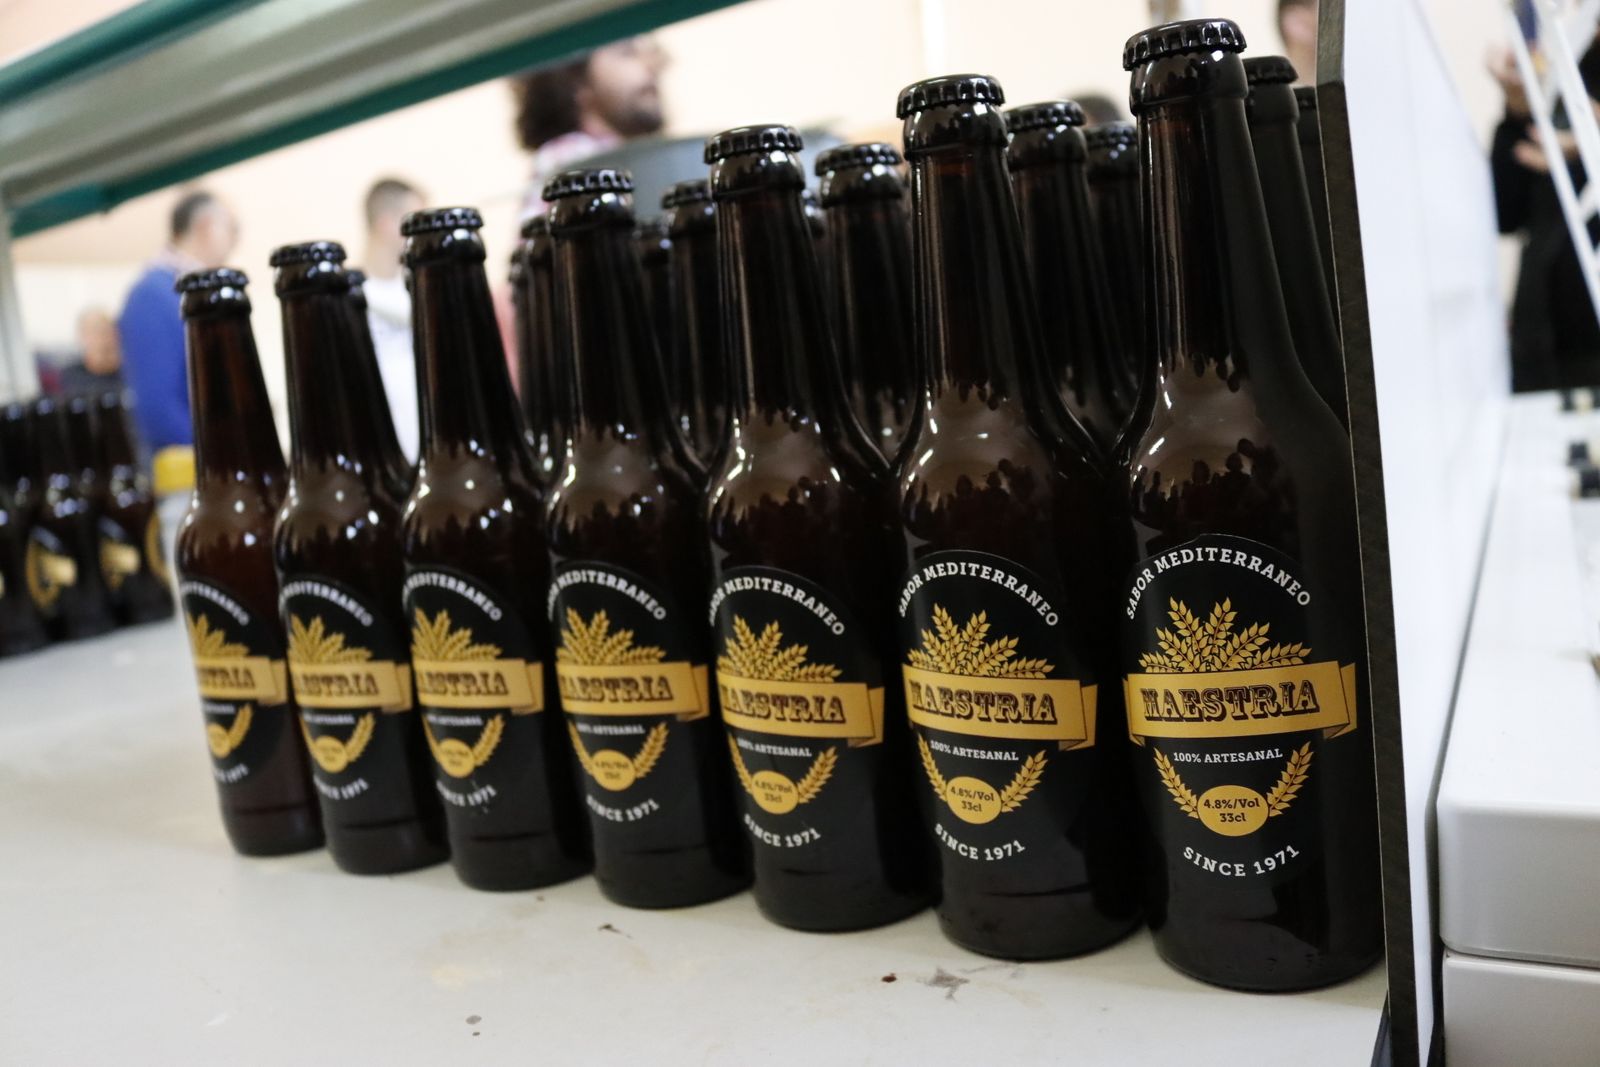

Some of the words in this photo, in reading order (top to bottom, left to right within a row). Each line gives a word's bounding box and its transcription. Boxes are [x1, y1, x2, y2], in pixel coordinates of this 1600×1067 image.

[899, 574, 924, 618] SABOR
[923, 562, 1059, 626] MEDITERRANEO
[1126, 567, 1155, 620] SABOR
[1155, 547, 1311, 606] MEDITERRANEO
[724, 576, 845, 636] MEDITERRANEO
[1140, 680, 1320, 722] MAESTRIA
[754, 744, 813, 757] ARTESANAL
[930, 740, 951, 754] 100%
[952, 746, 1019, 761] ARTESANAL
[1173, 752, 1202, 763] 100%
[1204, 748, 1283, 764] ARTESANAL
[950, 786, 995, 801] 4.8%/Vol
[961, 801, 982, 812] 33cl
[1203, 796, 1260, 810] 4.8%/Vol
[744, 813, 781, 847] SINCE
[785, 827, 822, 848] 1971
[1219, 812, 1247, 823] 33cl
[935, 823, 979, 861] SINCE
[985, 839, 1026, 861] 1971
[1183, 846, 1246, 877] SINCE
[1253, 844, 1299, 875] 1971
